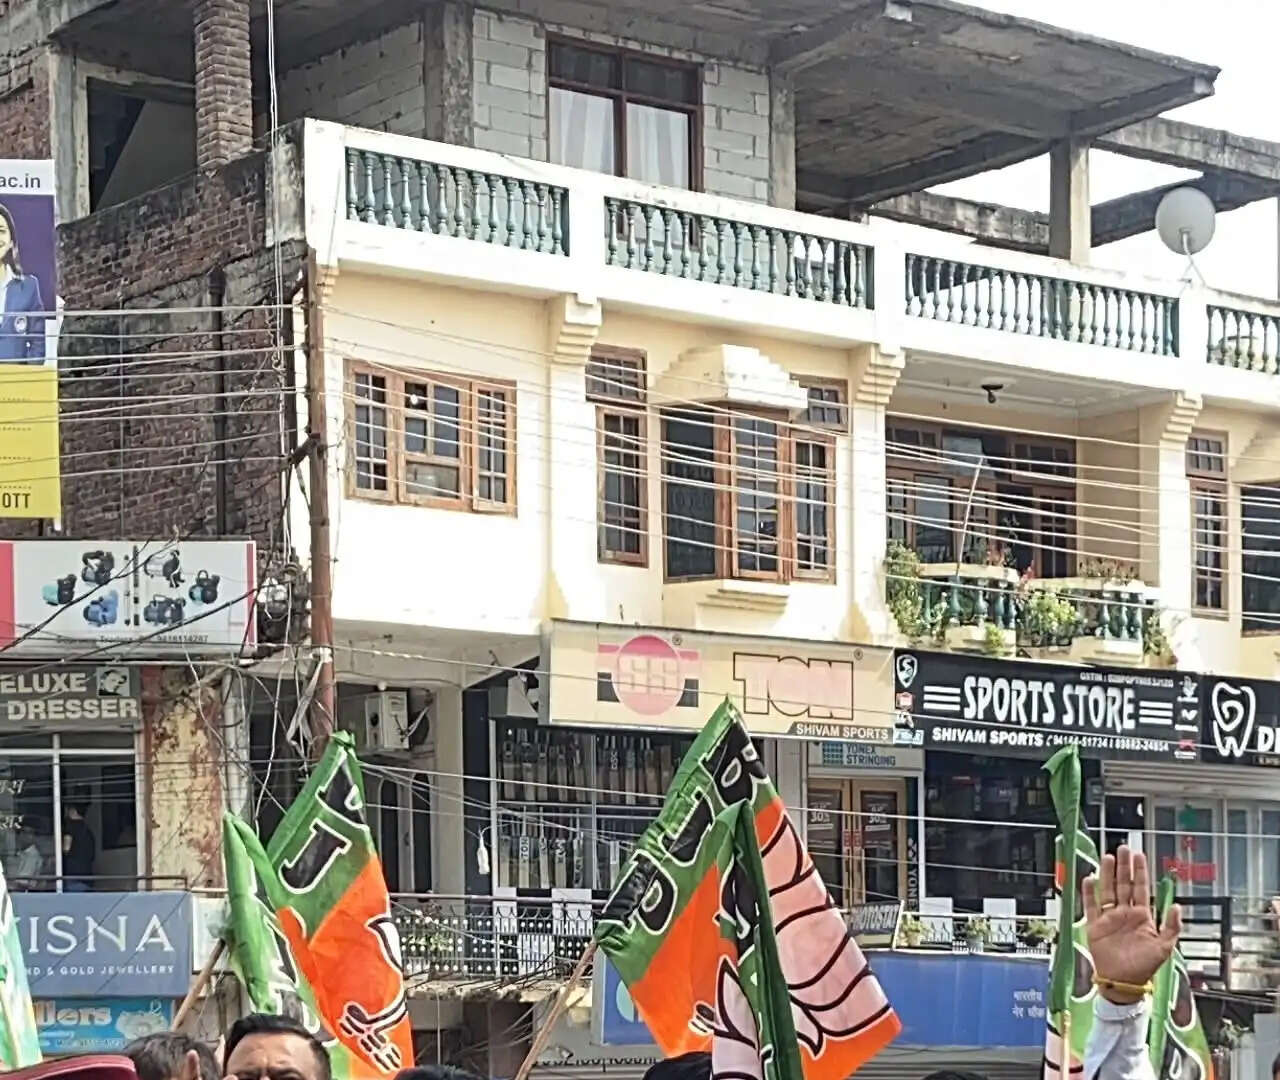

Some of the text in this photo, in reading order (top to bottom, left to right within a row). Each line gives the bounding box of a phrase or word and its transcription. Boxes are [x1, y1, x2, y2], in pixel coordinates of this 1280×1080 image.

[2, 492, 32, 509] OTT
[732, 651, 854, 720] TON
[8, 699, 139, 720] DRESSER
[963, 675, 1136, 733] SPORTS STORE
[796, 722, 889, 740] SHIVAM SPORTS
[932, 726, 987, 744] SHIVAM
[989, 731, 1044, 747] SPORTS
[14, 913, 176, 956] ISNA
[60, 966, 95, 976] GOLD
[100, 964, 175, 976] JEWELLERY
